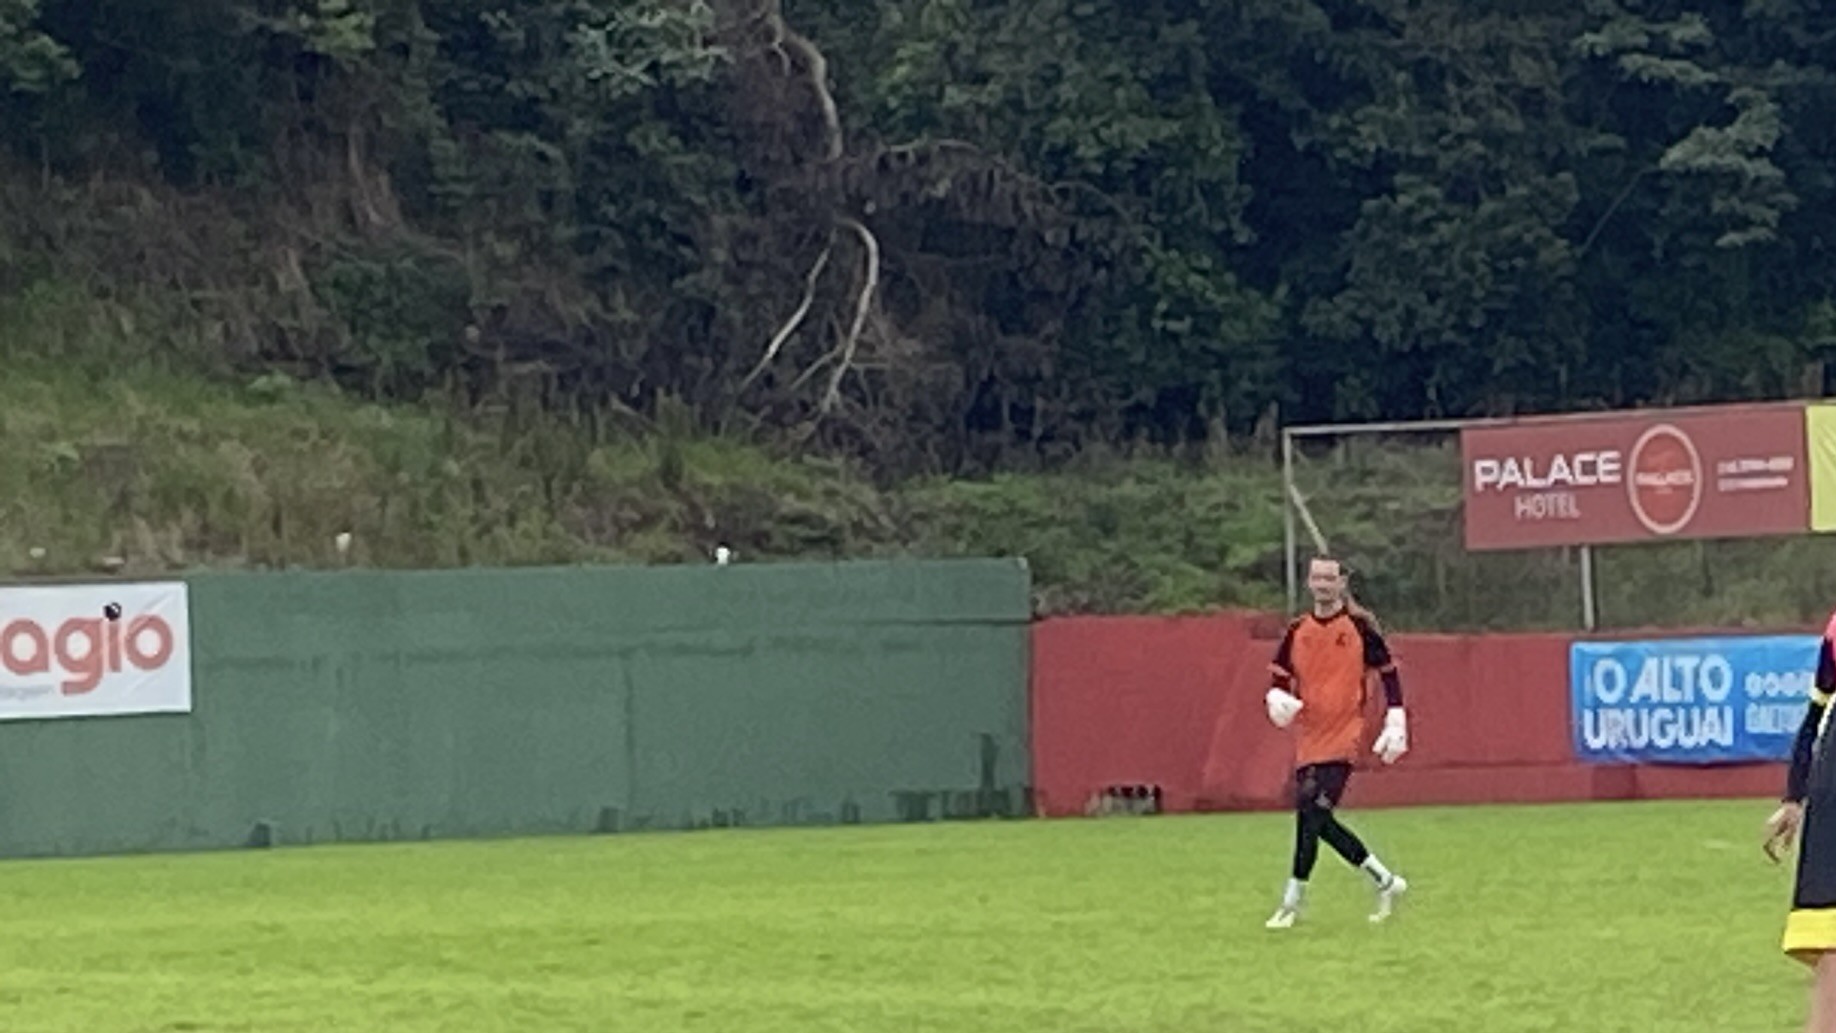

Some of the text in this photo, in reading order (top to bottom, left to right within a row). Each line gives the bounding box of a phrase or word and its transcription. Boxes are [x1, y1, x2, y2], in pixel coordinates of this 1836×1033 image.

[1474, 450, 1622, 493] PALACE
[1513, 492, 1582, 521] HOTEL
[0, 602, 174, 697] agio
[1593, 657, 1628, 704] O
[1629, 654, 1734, 703] ALTO
[1583, 705, 1735, 749] URUGUAI
